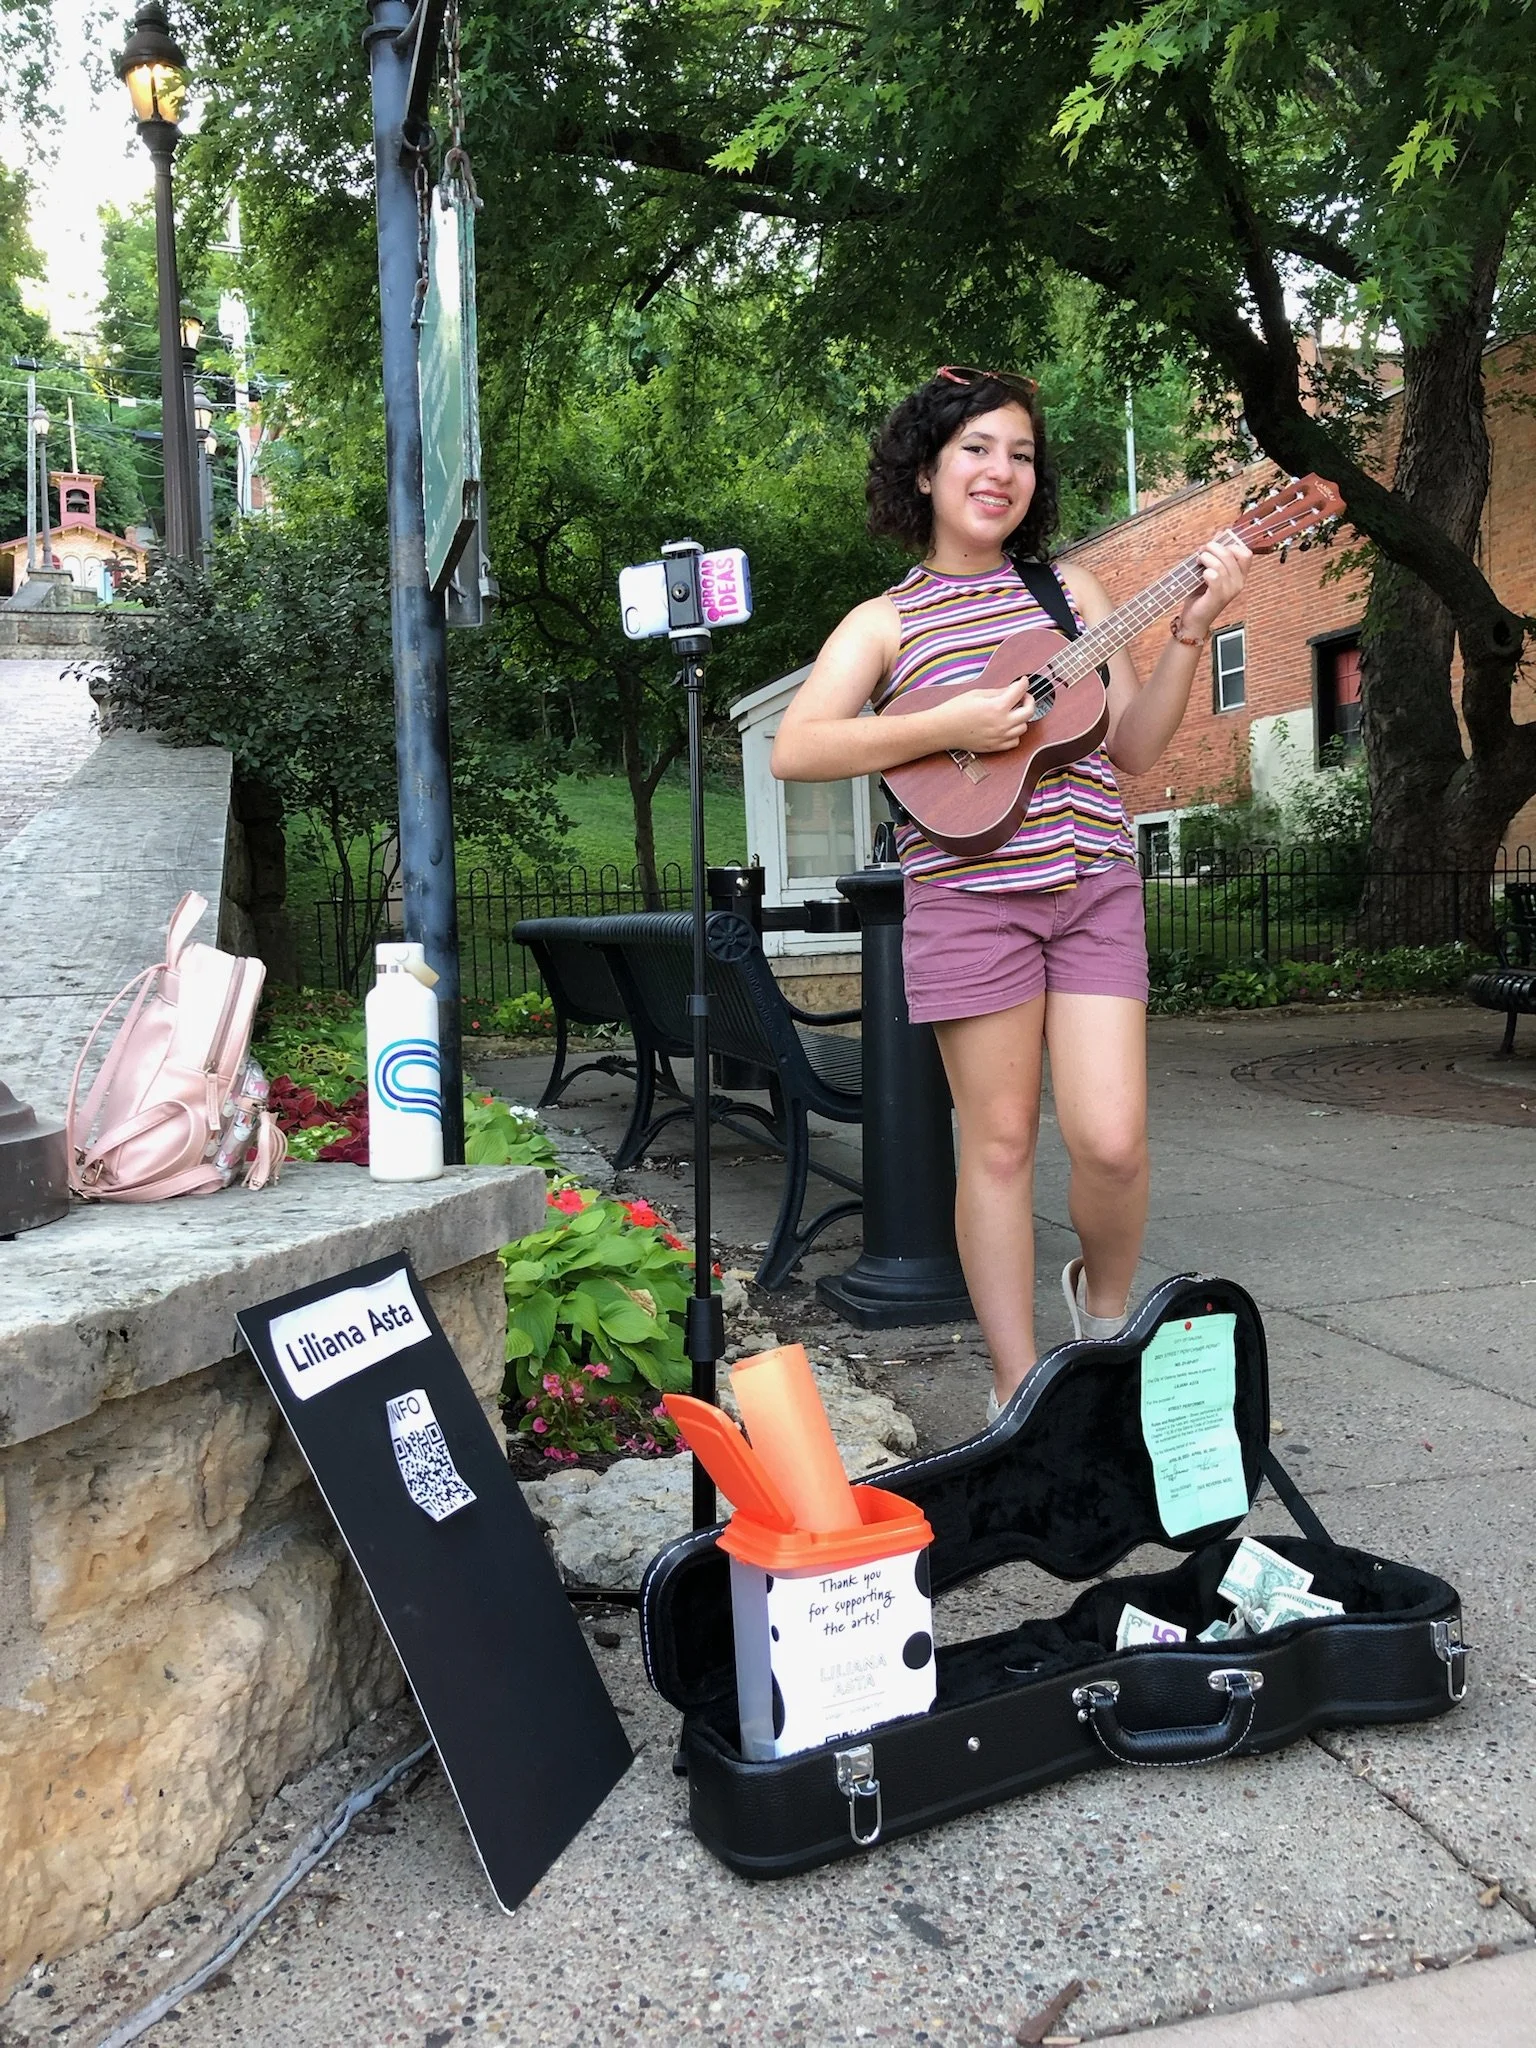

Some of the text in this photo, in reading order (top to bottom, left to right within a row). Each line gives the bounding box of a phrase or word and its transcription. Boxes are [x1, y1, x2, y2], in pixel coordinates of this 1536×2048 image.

[701, 559, 715, 608] BROAD
[716, 557, 739, 618] IDEAS
[286, 1304, 414, 1373] Liliana Asta
[388, 1396, 421, 1424] INFO
[819, 1570, 882, 1594] Thank you
[809, 1588, 896, 1623] for supporting
[823, 1609, 880, 1636] the arts!
[820, 1652, 888, 1683] LILIANA
[833, 1674, 875, 1698] ASTA
